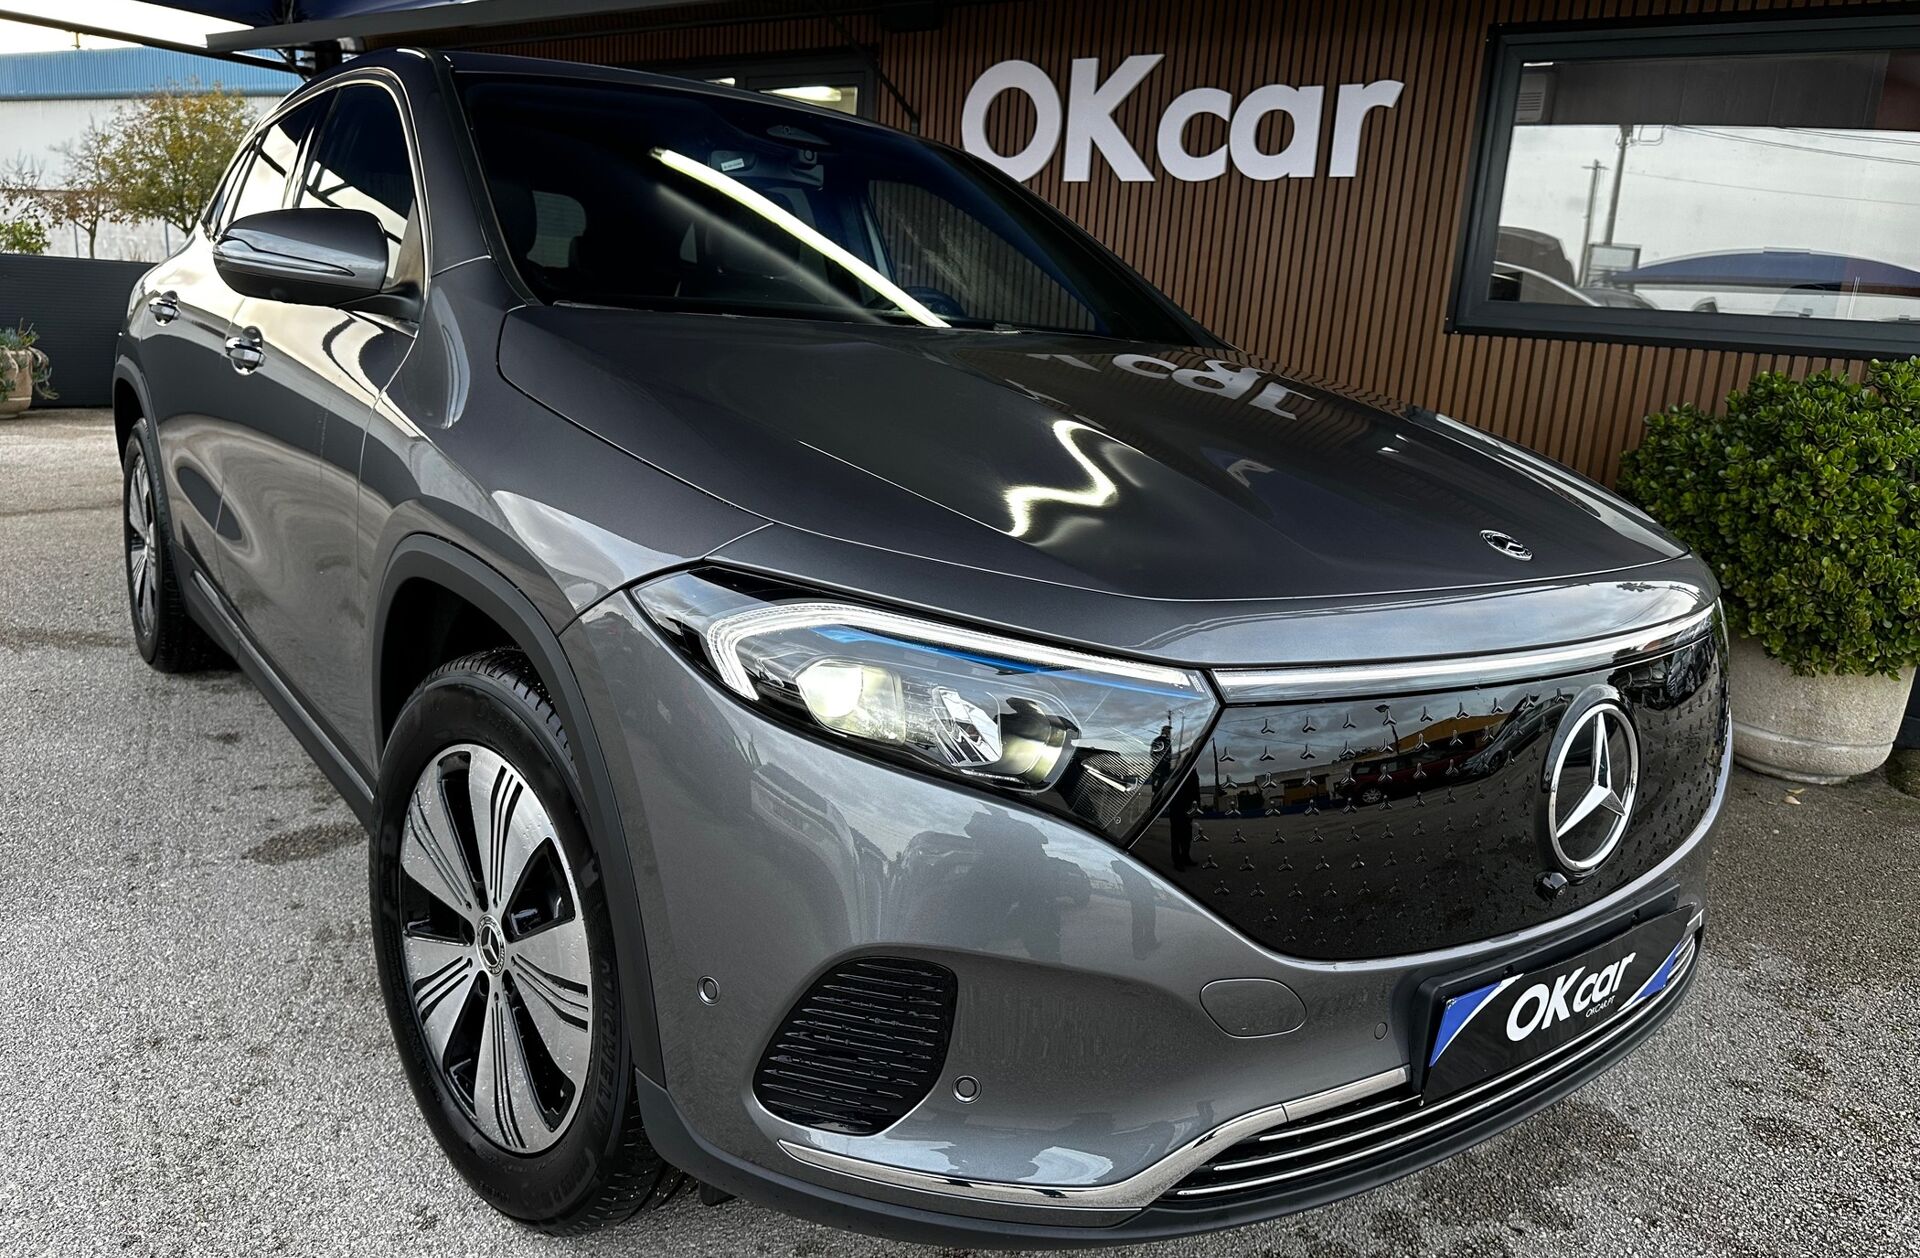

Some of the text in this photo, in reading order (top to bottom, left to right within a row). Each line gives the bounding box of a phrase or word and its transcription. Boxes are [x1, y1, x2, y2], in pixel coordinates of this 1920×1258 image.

[961, 53, 1406, 184] OKcar
[592, 957, 617, 1136] MICHELIN
[1505, 952, 1637, 1042] OKcar
